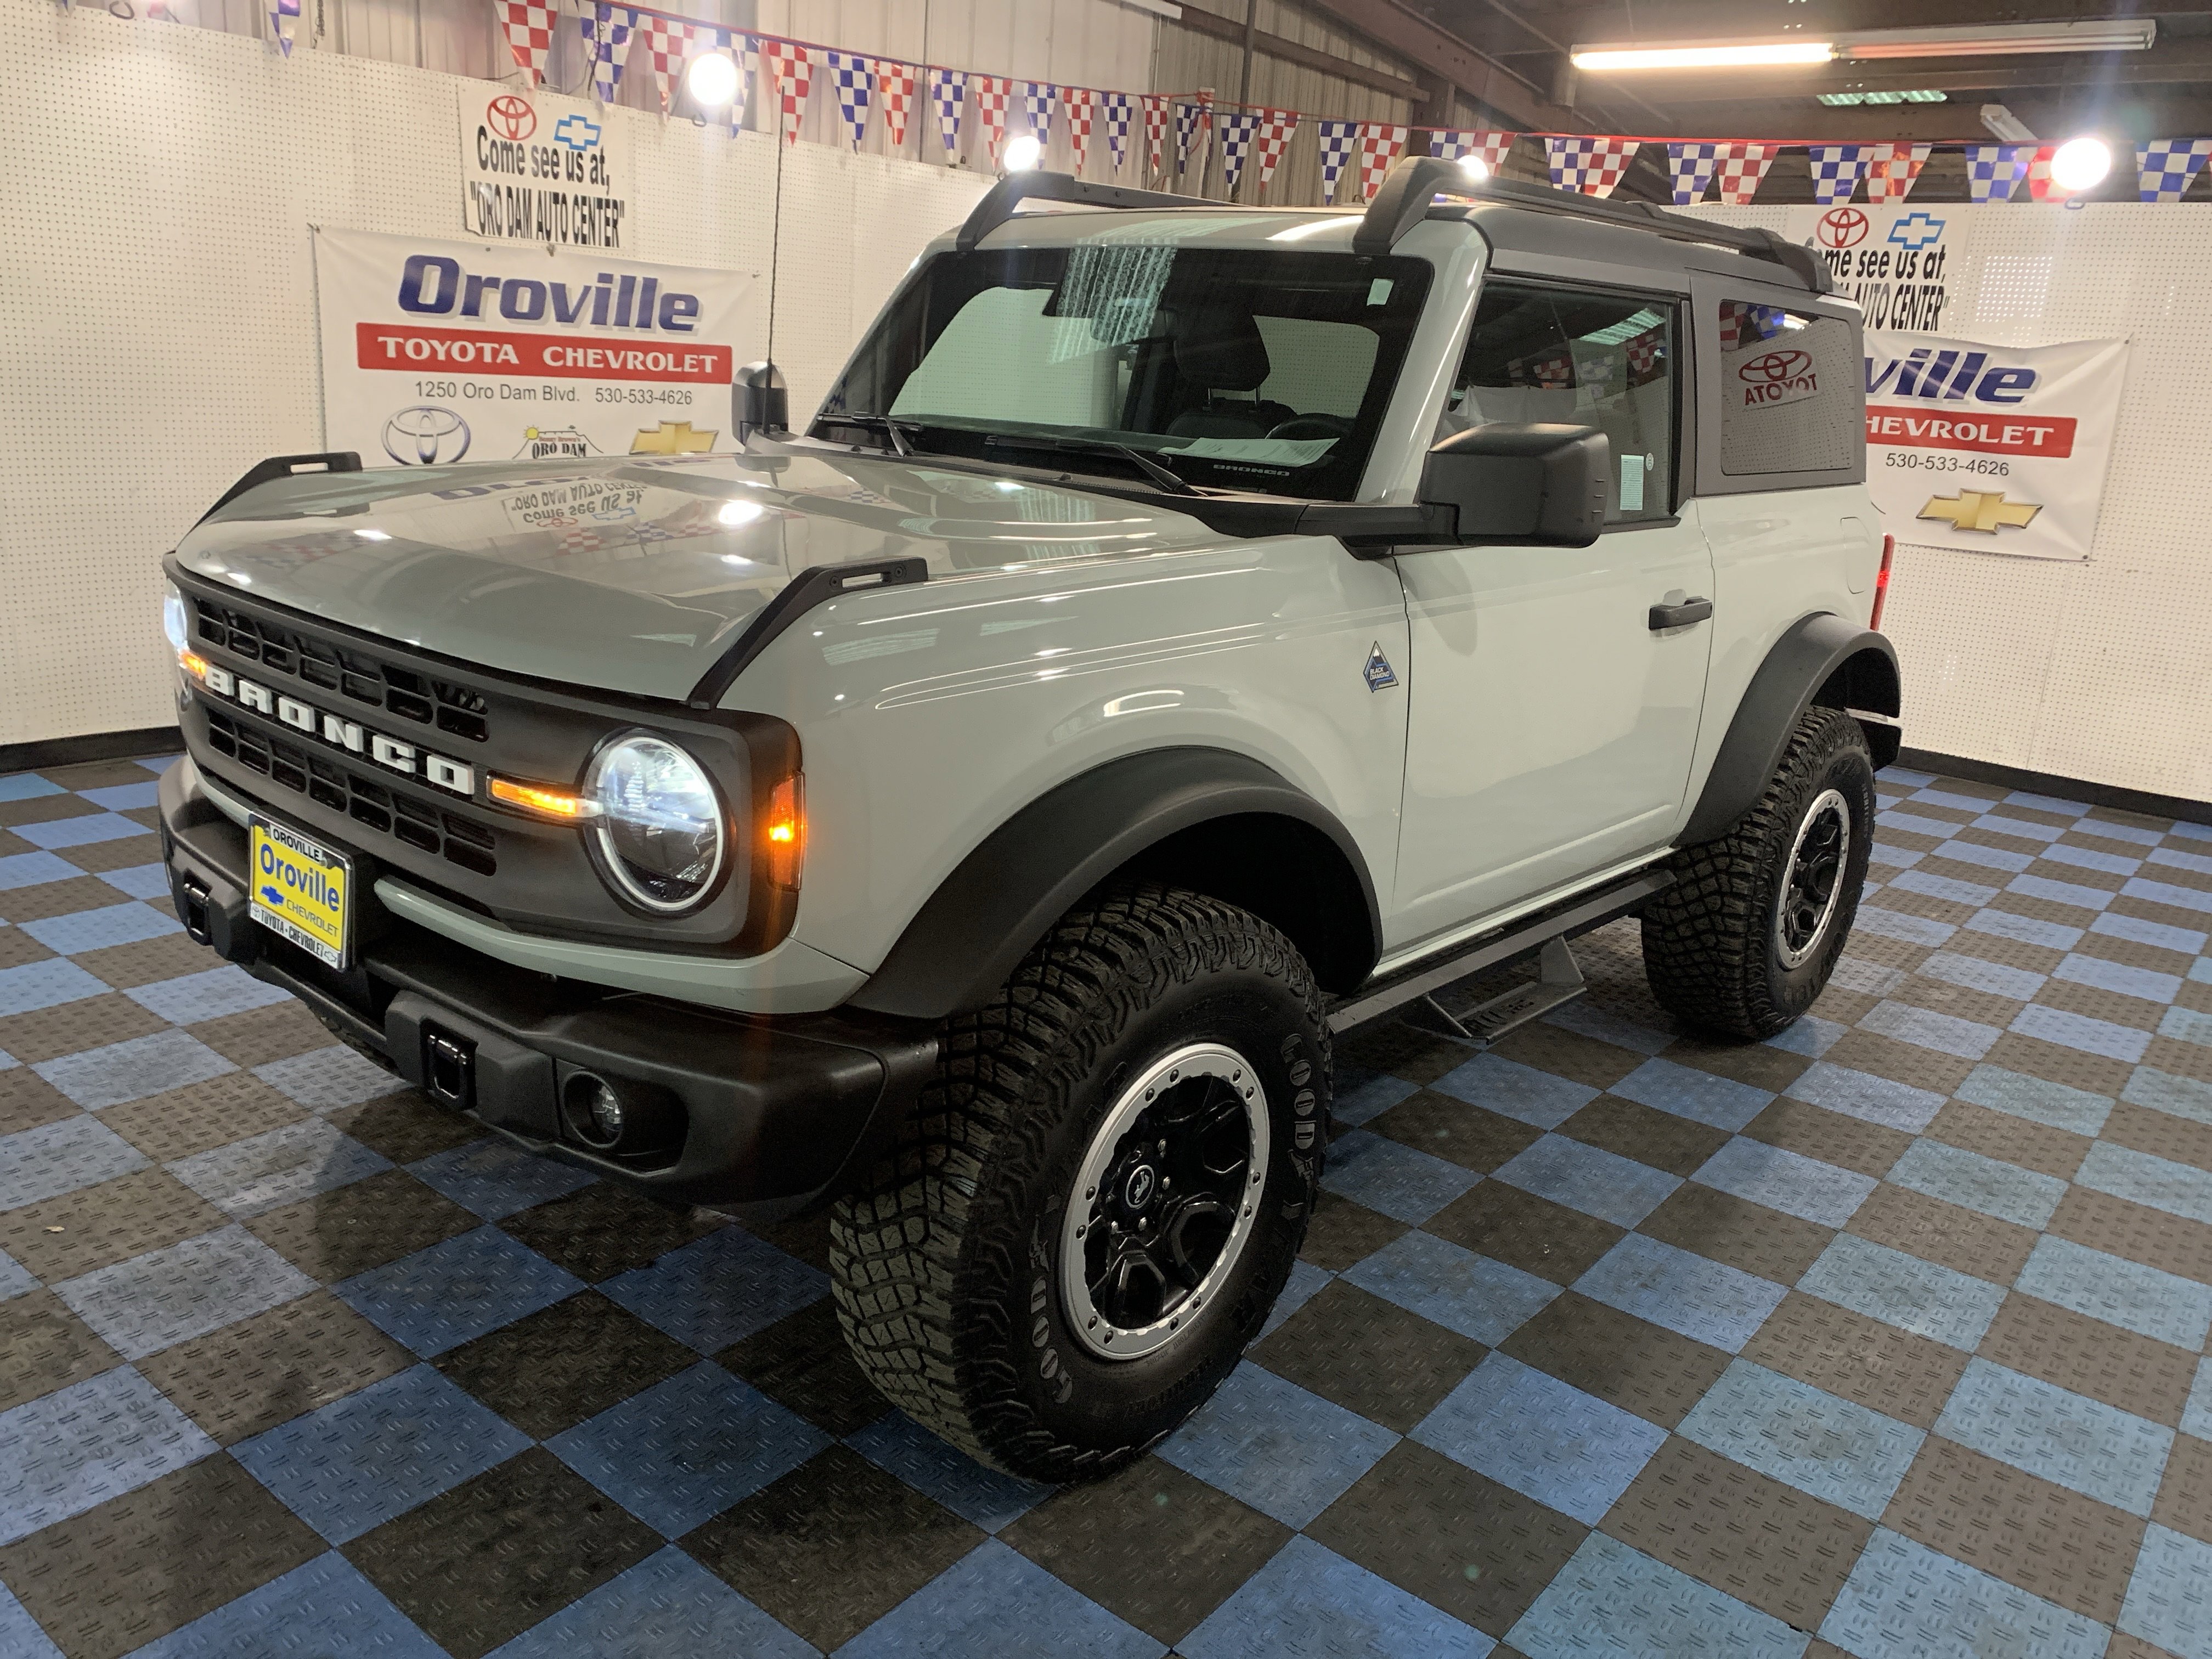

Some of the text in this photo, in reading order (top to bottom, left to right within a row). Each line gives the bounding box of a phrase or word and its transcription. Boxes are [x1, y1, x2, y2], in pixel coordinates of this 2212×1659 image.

[477, 125, 610, 196] Come see us at,
[506, 185, 532, 239] DAM
[536, 189, 568, 243] AUTO
[572, 193, 625, 248] CENTER"
[1856, 250, 1891, 279] see
[1895, 250, 1919, 279] us
[1923, 244, 1946, 283] at,
[398, 253, 699, 331] Oroville
[377, 336, 718, 374] TOYOTA CHEVROLET
[415, 381, 693, 406] 1250 Oro Dam Blvd. 530-533-4626
[1865, 348, 2037, 403] ville
[1866, 415, 2055, 446] HEVROLET
[532, 442, 586, 459] ORO DAM
[1885, 452, 2010, 477] 530-533-4626
[205, 667, 476, 795] BRONCO
[272, 828, 319, 862] OROVILLE
[260, 843, 340, 912] Oroville
[261, 910, 324, 957] TOYOTA CHEVROLET
[286, 899, 339, 937] CHEVROLET
